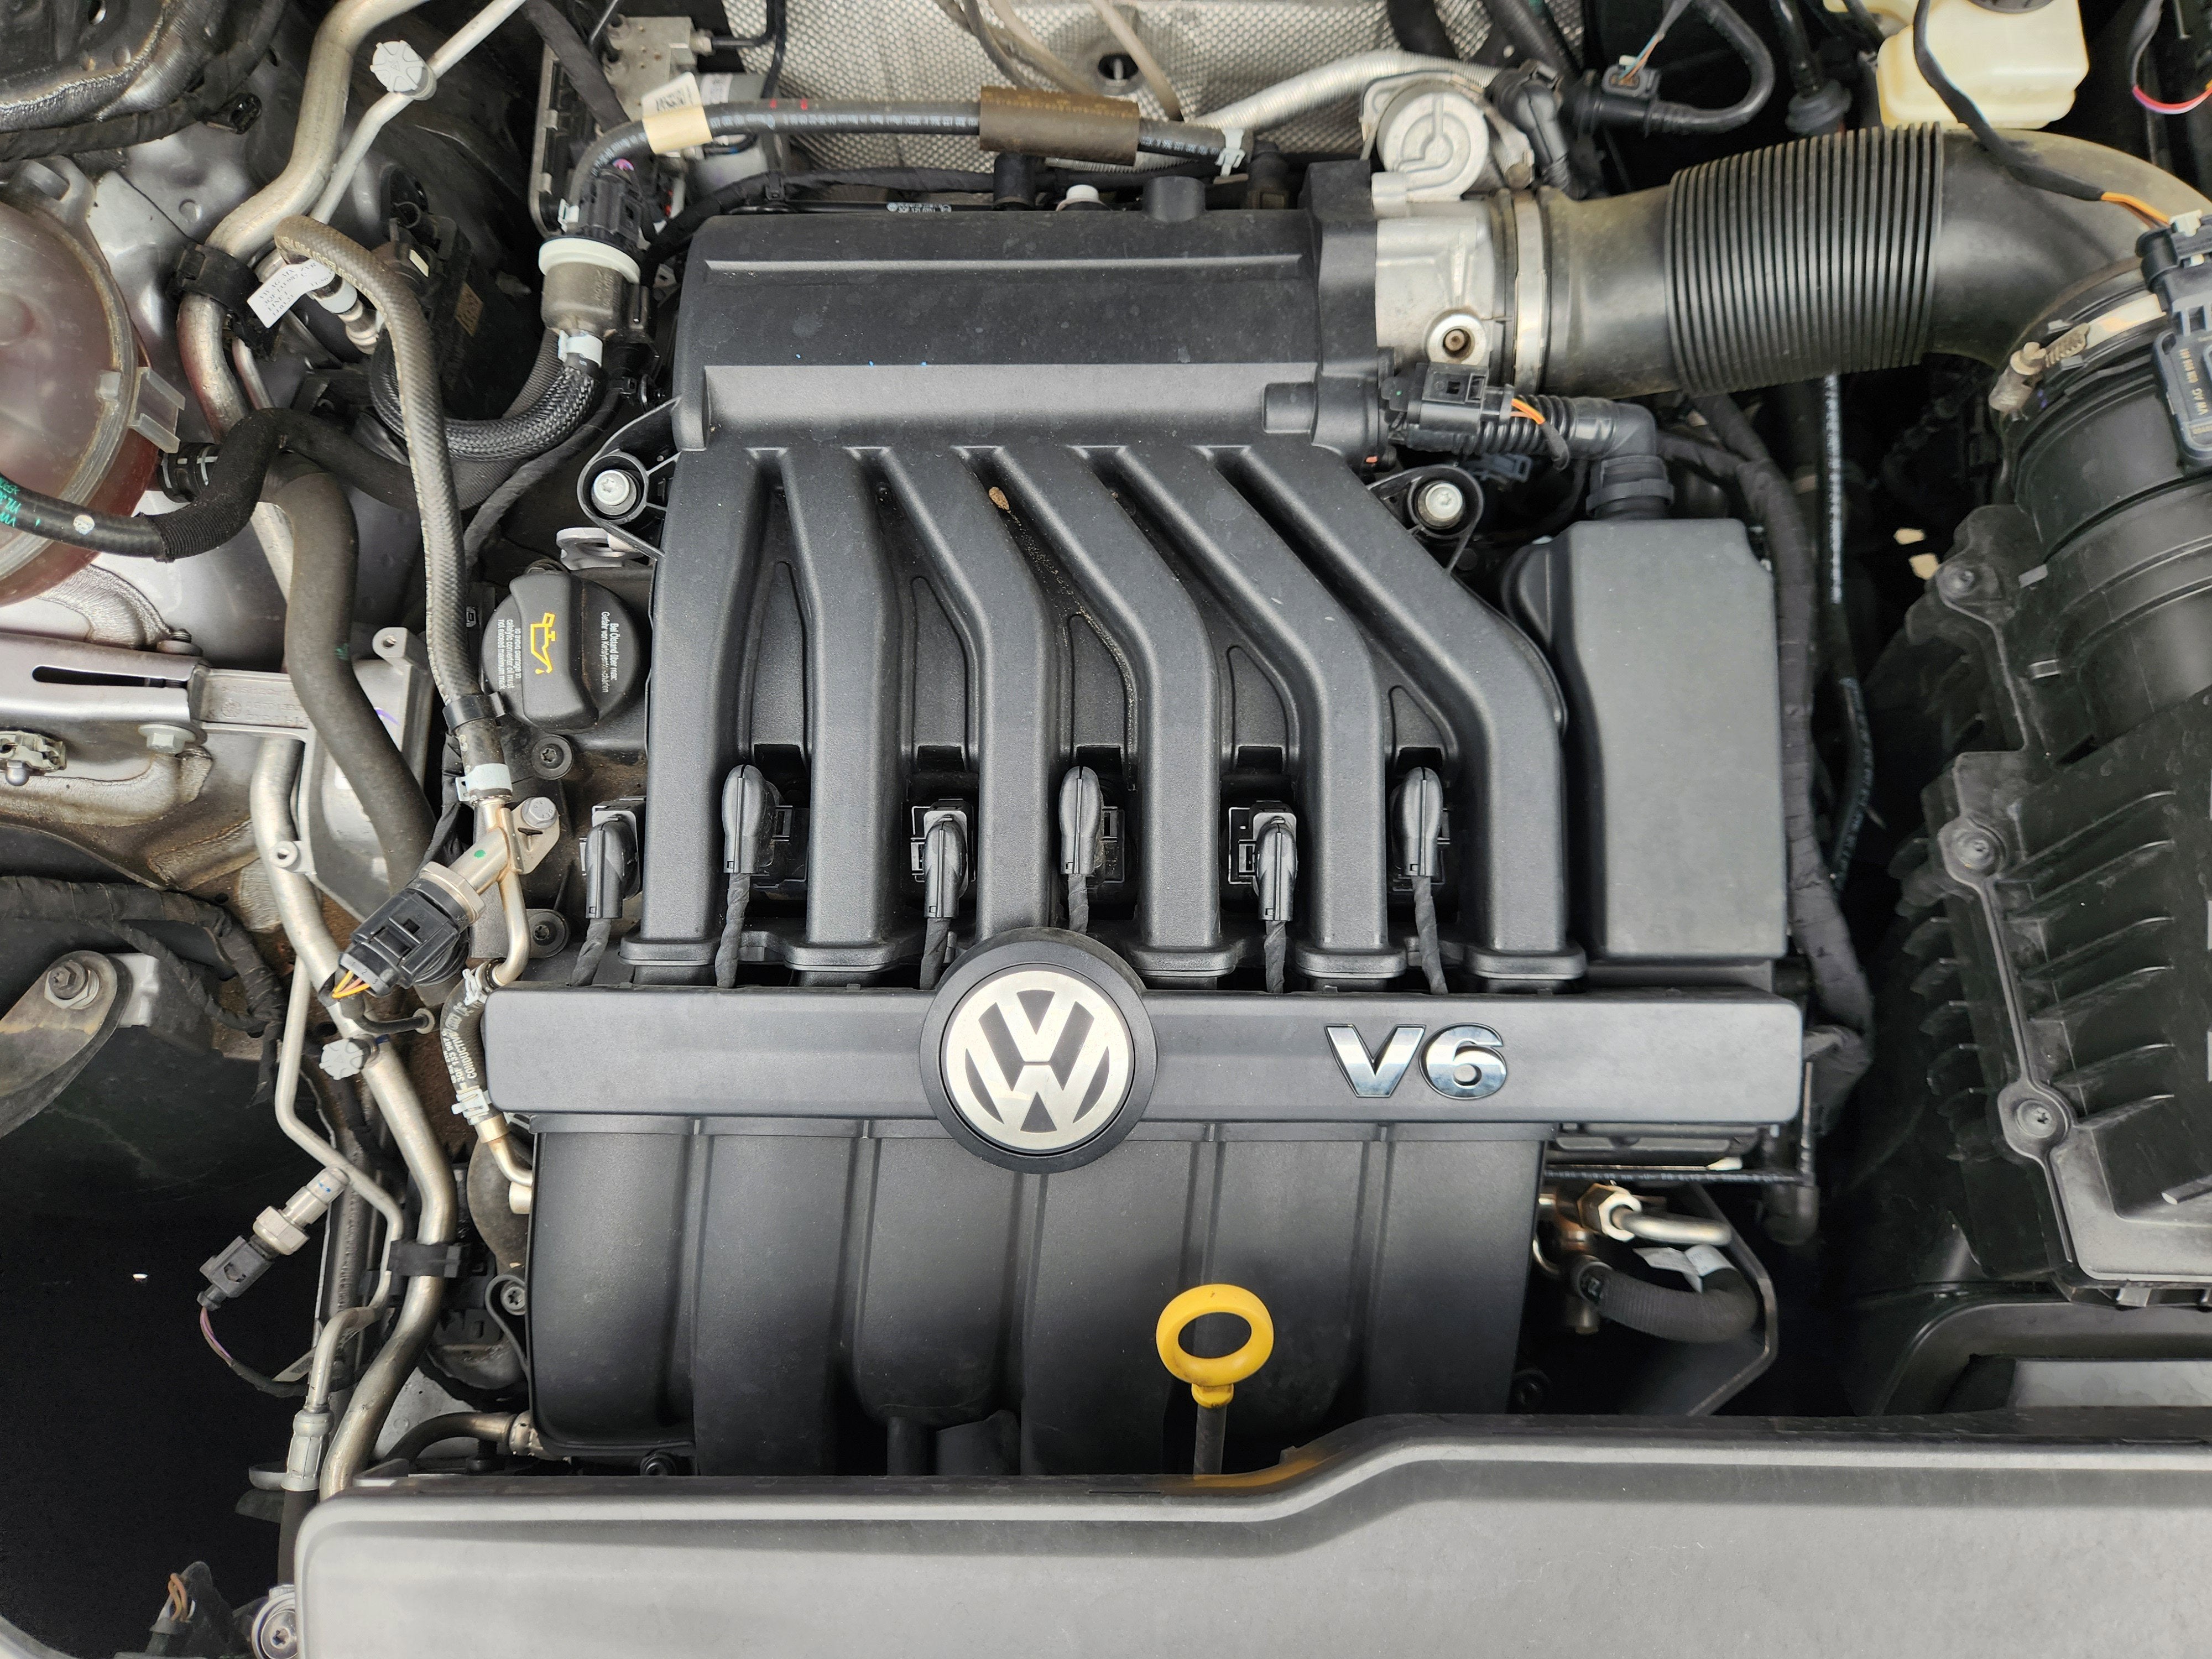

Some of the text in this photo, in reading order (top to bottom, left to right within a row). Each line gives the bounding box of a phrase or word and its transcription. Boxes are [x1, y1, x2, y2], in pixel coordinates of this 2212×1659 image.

[505, 619, 514, 640] catalytic
[601, 611, 610, 629] Gefahr
[498, 628, 506, 648] exceed
[609, 633, 620, 653] Ölstand
[498, 648, 506, 674] maximum
[498, 675, 507, 690] mark
[946, 971, 1129, 1150] VW
[1326, 1022, 1507, 1100] V6
